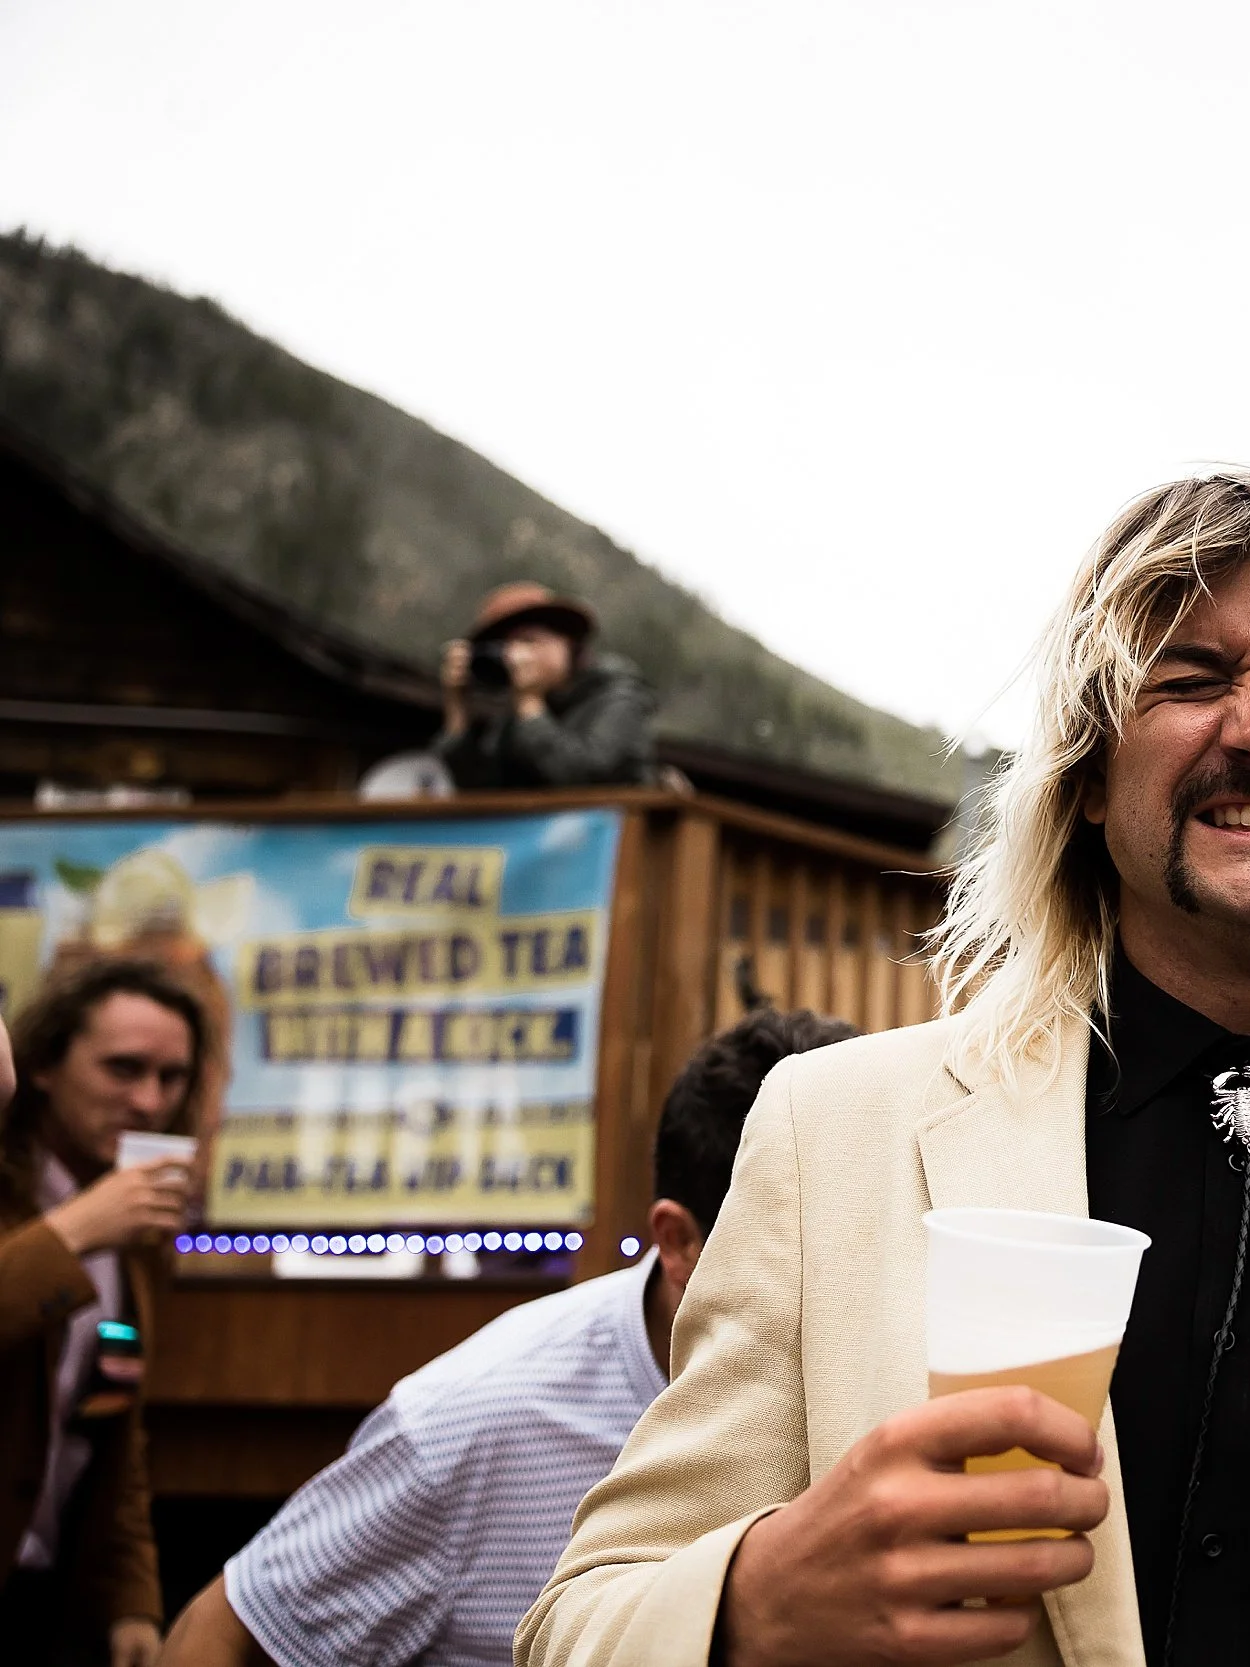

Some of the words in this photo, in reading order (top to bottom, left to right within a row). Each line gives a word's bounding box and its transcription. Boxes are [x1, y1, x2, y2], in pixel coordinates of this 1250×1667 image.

[364, 860, 484, 906] REAL
[256, 932, 482, 993] BREWED
[500, 925, 589, 978] TEA
